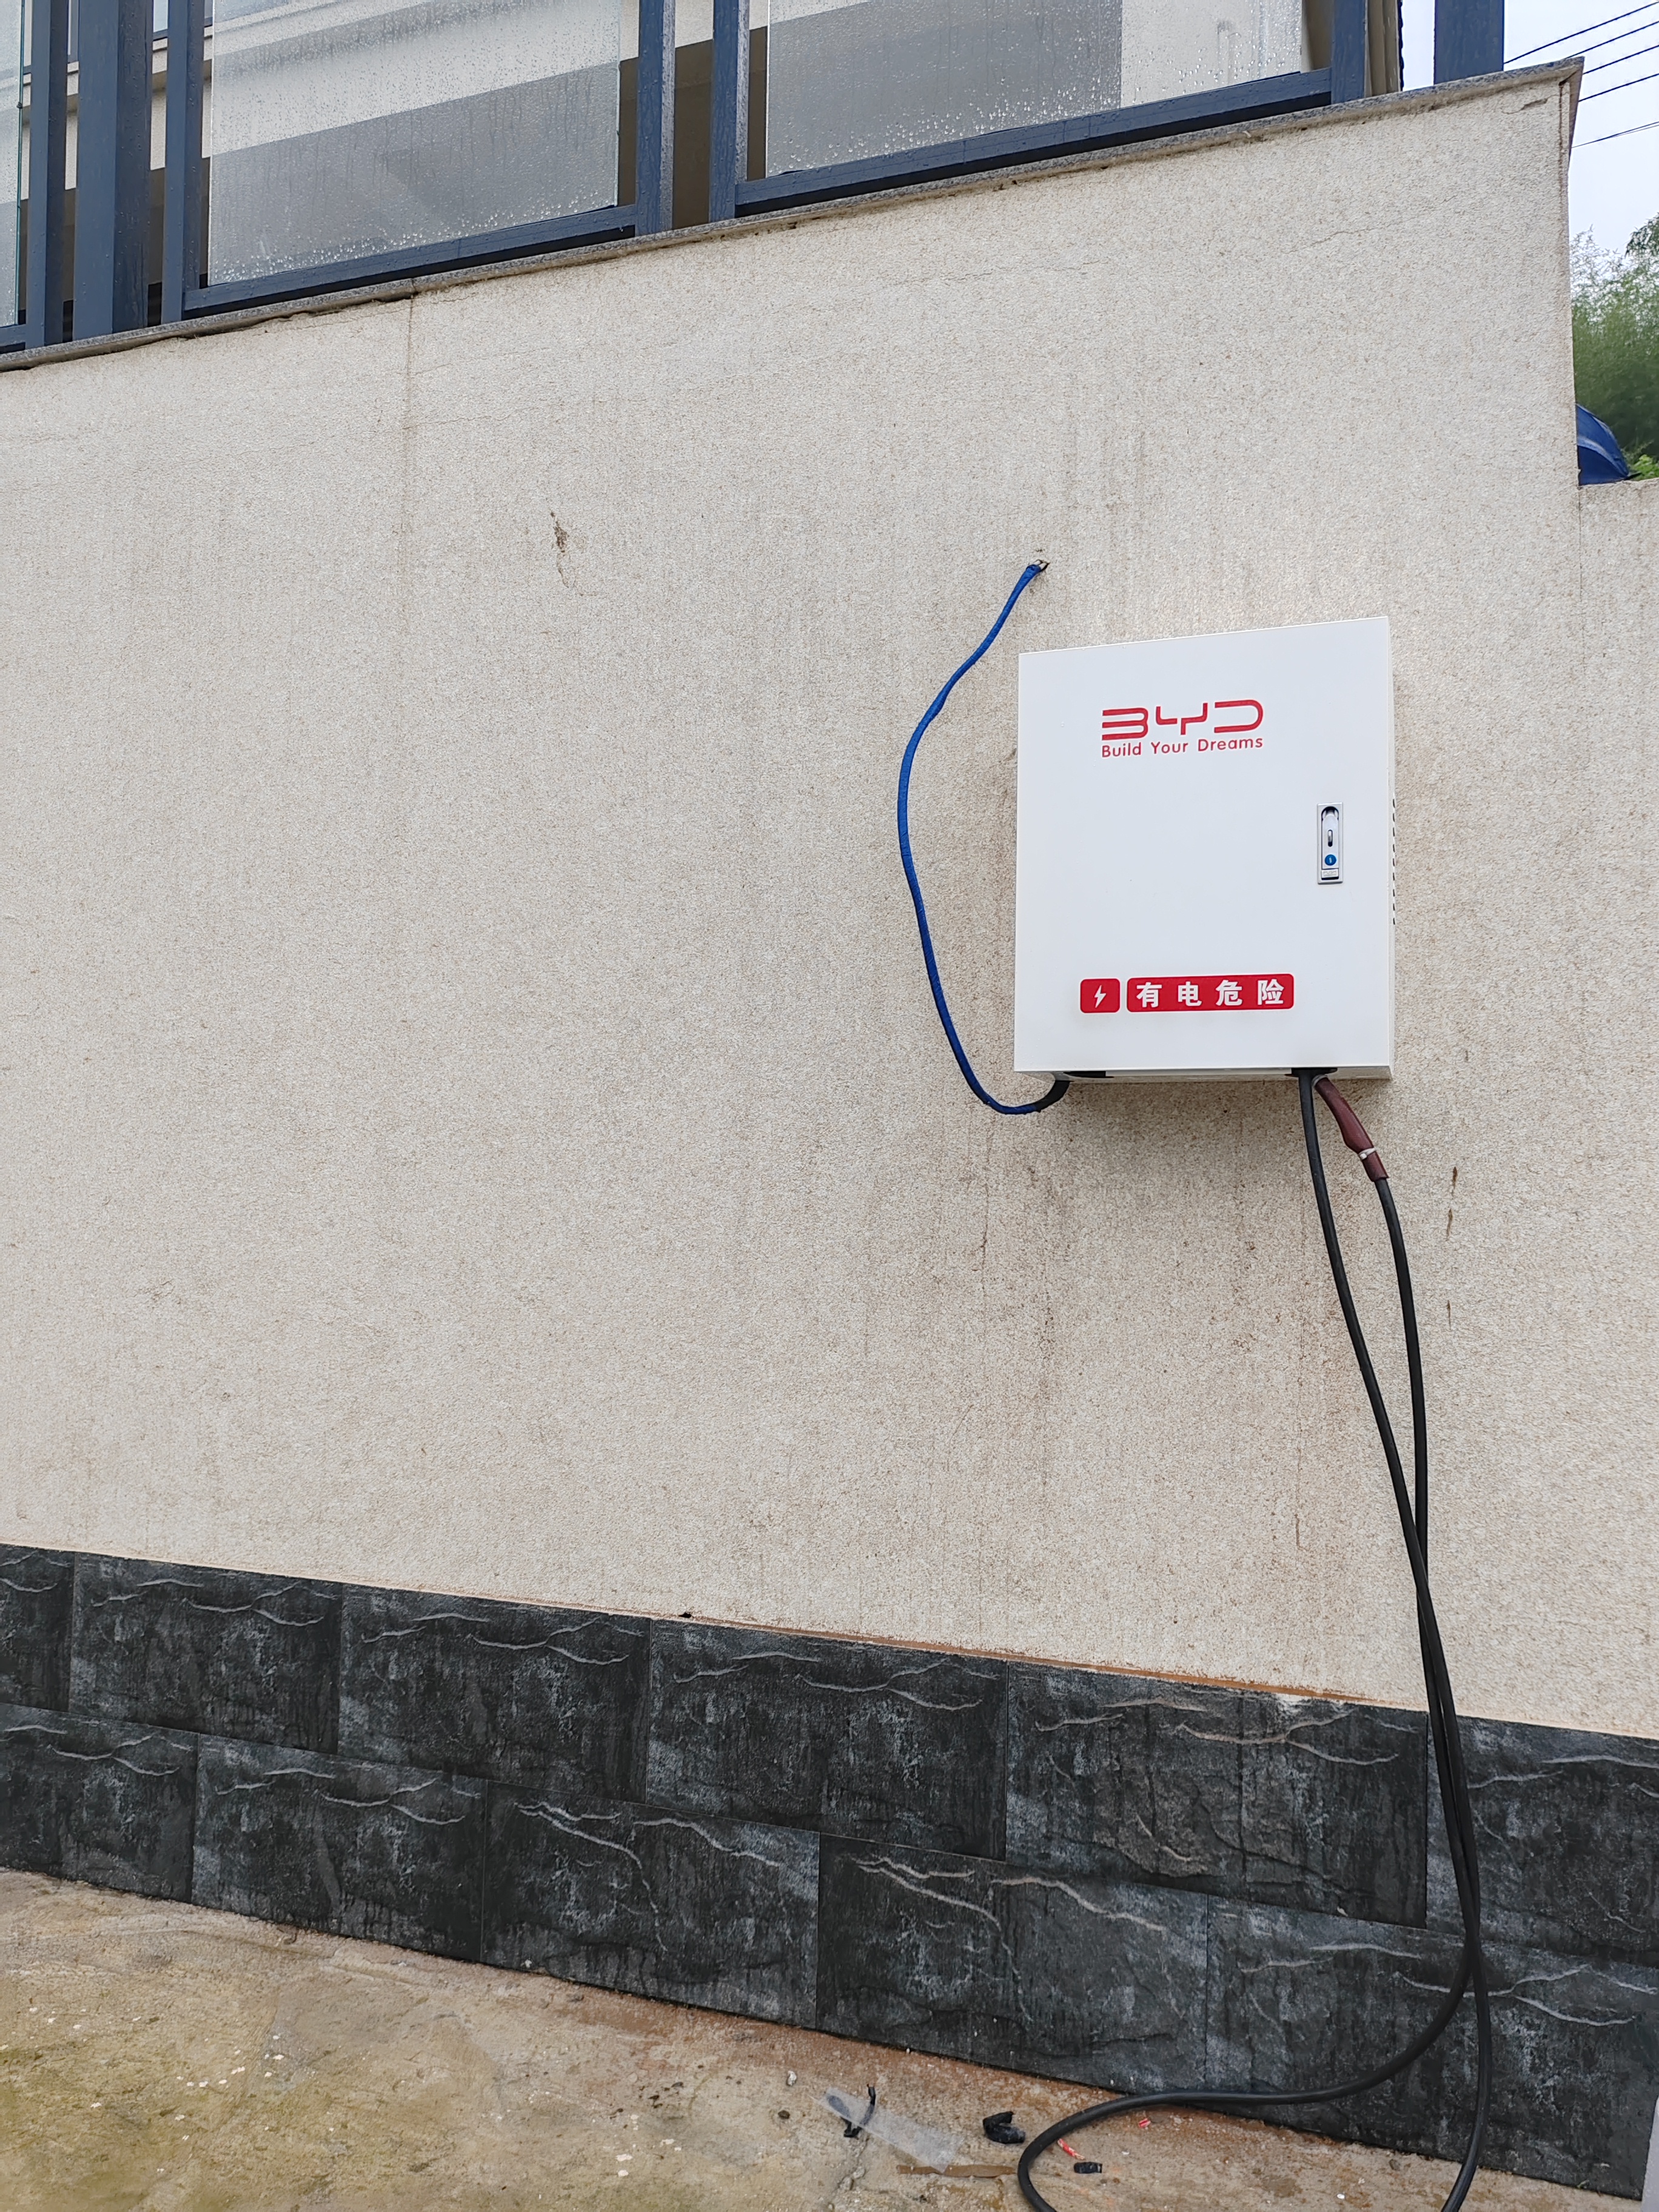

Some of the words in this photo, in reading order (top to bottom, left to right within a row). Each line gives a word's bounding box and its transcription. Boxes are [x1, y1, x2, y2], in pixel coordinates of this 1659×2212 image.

[1102, 699, 1264, 740] BYD
[1102, 743, 1141, 757] Build
[1151, 742, 1188, 754] Your
[1198, 737, 1263, 751] Dreams
[1136, 978, 1285, 1008] 有电危险
